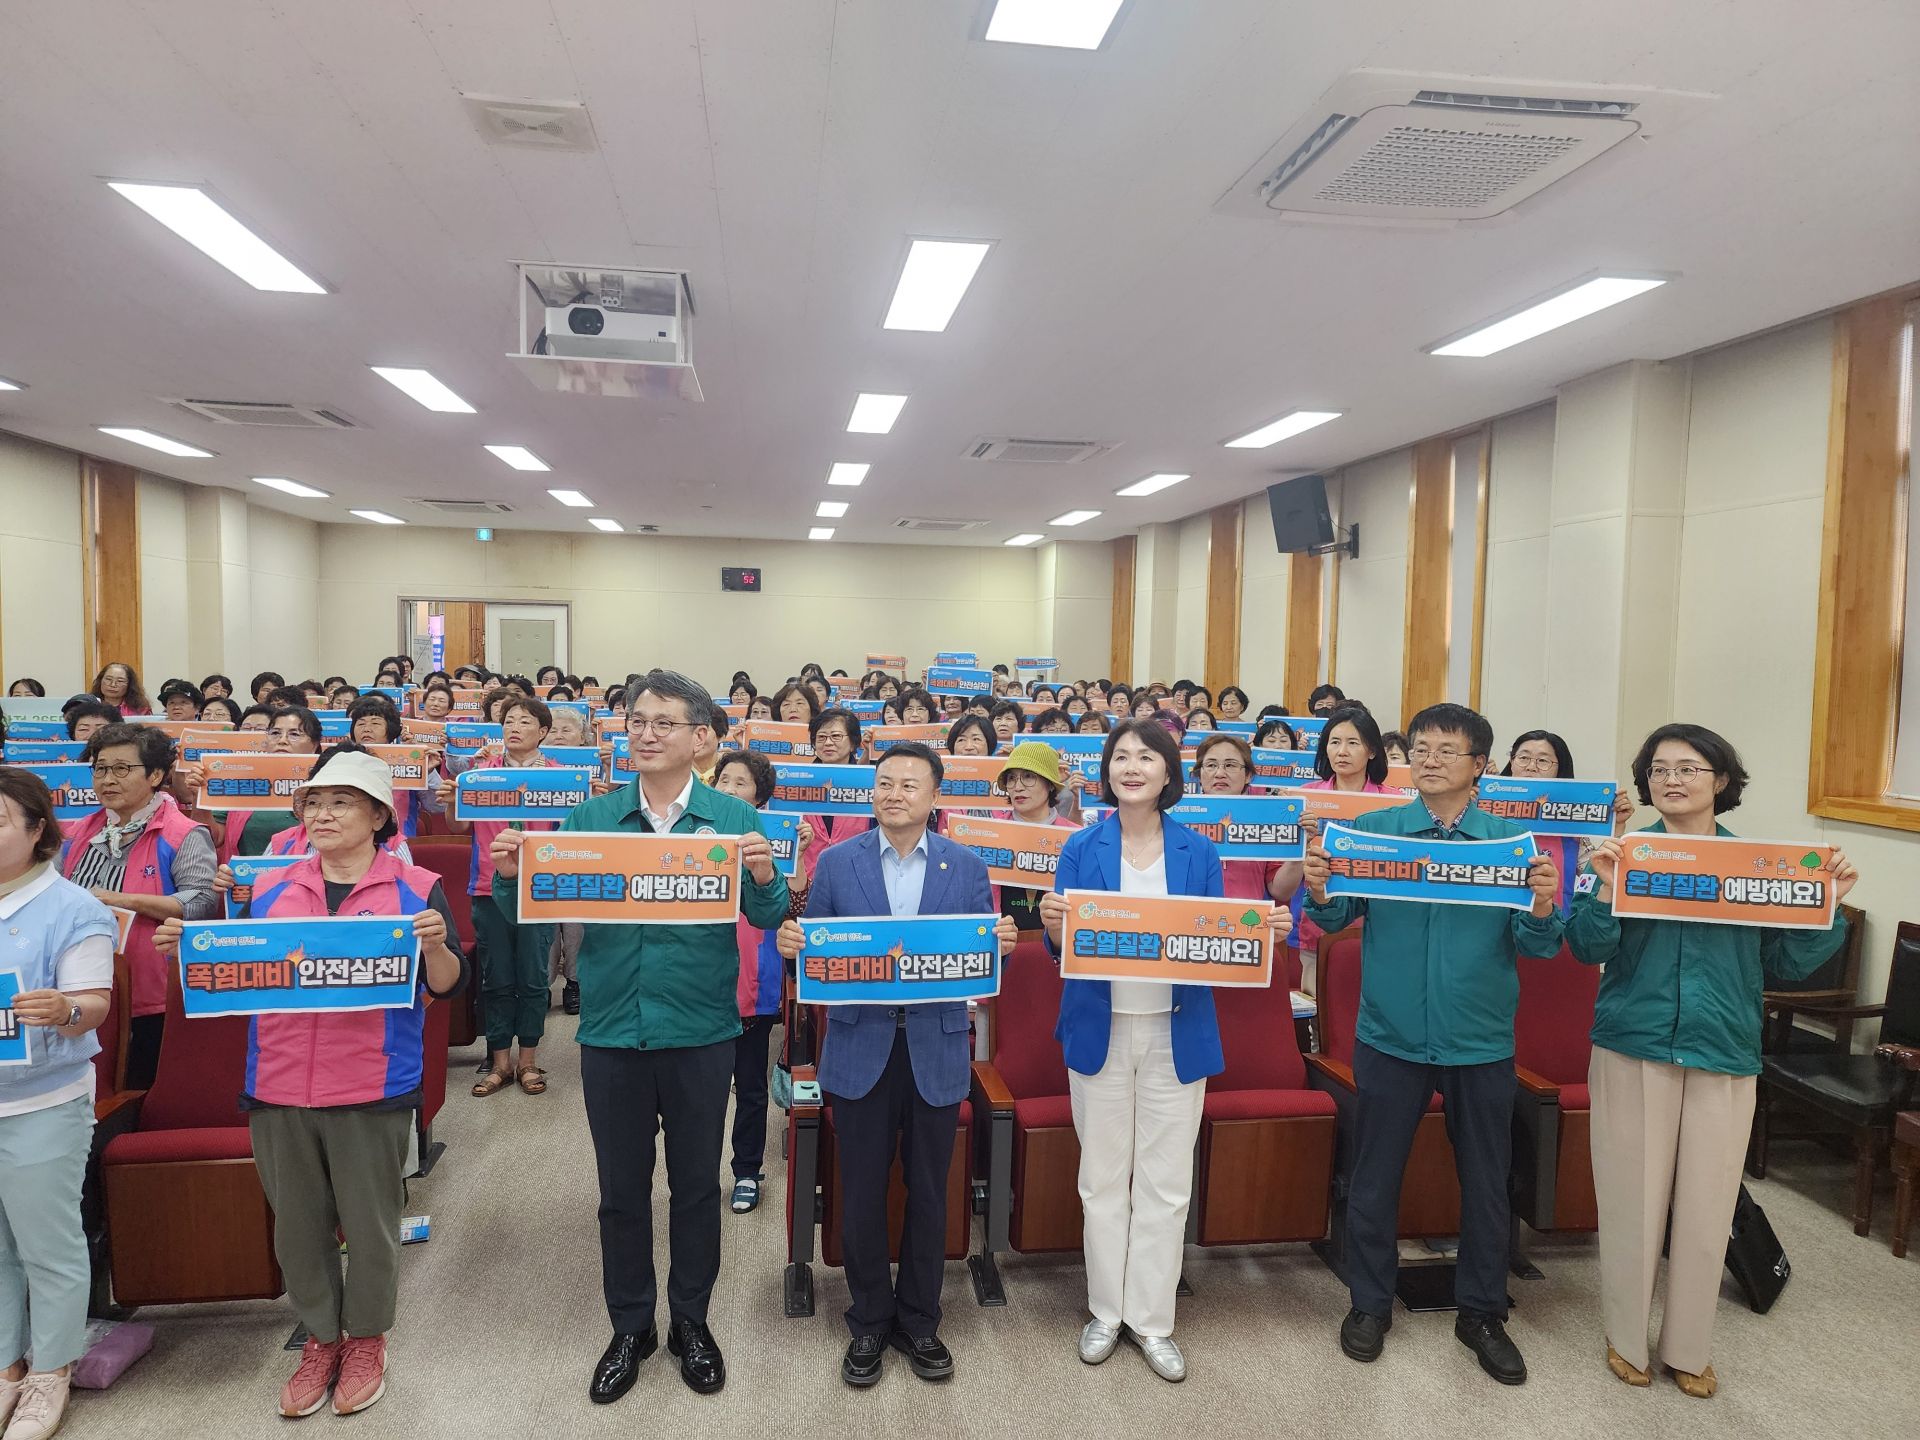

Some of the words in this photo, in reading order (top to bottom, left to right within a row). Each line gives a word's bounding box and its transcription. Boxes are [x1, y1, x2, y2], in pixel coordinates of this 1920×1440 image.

[749, 740, 792, 755] 온열질환
[793, 743, 818, 756] 예방
[392, 765, 421, 779] 해요!
[1294, 766, 1320, 779] 안전
[207, 778, 270, 796] 온열질환
[773, 785, 826, 801] 폭염대비
[461, 790, 519, 807] 폭염대비
[523, 791, 584, 807] 안전실천!
[1541, 802, 1608, 822] 안전실천!
[1190, 824, 1223, 842] 대비
[1227, 824, 1298, 843] 안전실천!
[1329, 857, 1419, 880] 폭염대비
[1426, 863, 1526, 886] 안전실천!
[531, 874, 626, 900] 온열질환
[631, 875, 728, 900] 예방해요!
[1626, 870, 1719, 901] 온열질환
[1724, 876, 1823, 906] 예방해요!
[1074, 929, 1161, 959] 온열질환
[1166, 935, 1260, 964] 예방해요!
[186, 959, 291, 991] 폭염대비
[299, 956, 407, 986] 안전실천!
[805, 955, 893, 982] 폭염대비
[899, 952, 991, 979] 안전실천!
